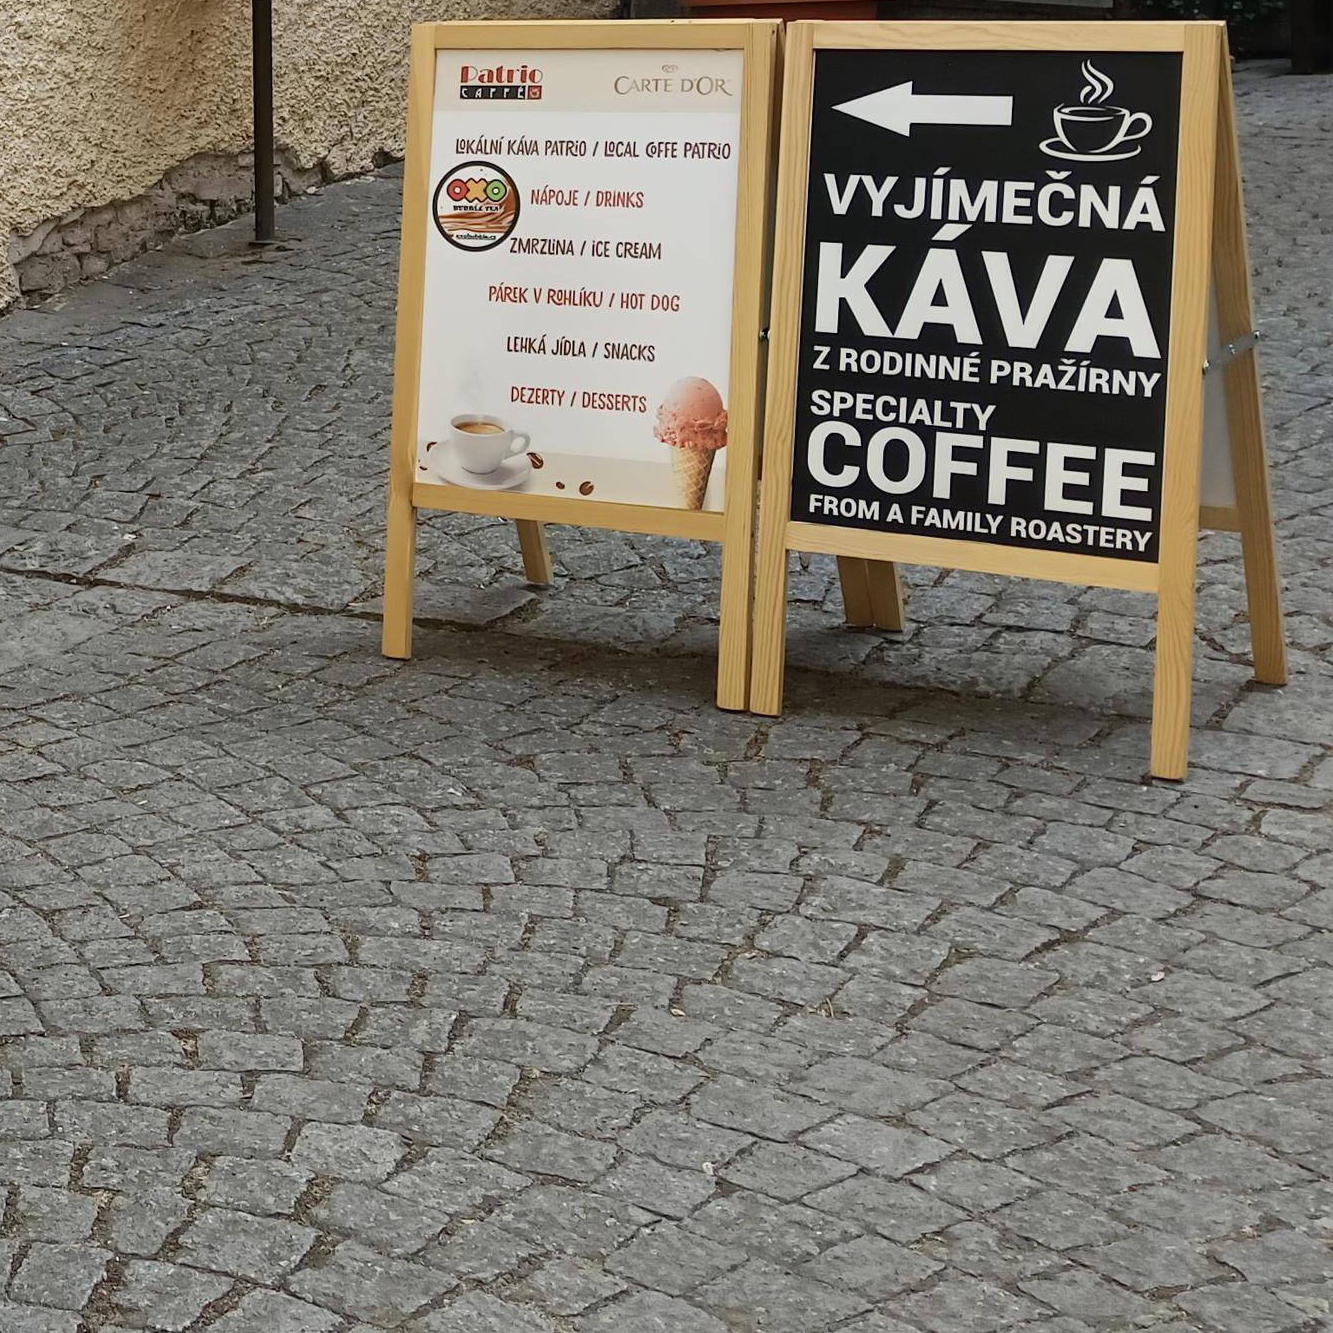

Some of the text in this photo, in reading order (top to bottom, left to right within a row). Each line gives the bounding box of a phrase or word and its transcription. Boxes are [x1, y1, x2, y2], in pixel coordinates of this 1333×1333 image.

[461, 65, 543, 83] Patrio
[614, 75, 733, 96] CARTE D'OR
[455, 134, 505, 155] LOKÁLNÍ
[507, 134, 540, 156] KÁVA
[604, 140, 640, 158] LOCAL
[530, 184, 579, 206] NÁPOJE
[595, 190, 644, 209] DRINKS
[823, 166, 1166, 233] VYJÍMEČNÁ
[615, 241, 662, 260] CREAM
[488, 282, 529, 303] PÁREK
[533, 288, 542, 304] V
[546, 286, 604, 308] ROHLÍKU
[620, 292, 646, 310] HOT
[650, 294, 681, 312] DOG
[813, 223, 1162, 360] KÁVA
[506, 334, 547, 355] LEHKÁ
[551, 336, 587, 358] JÍDLA
[603, 342, 656, 363] SNACKS
[812, 345, 1162, 398] Z RODINNÉ PRAŽÍRNY
[510, 385, 566, 407] DEZERTY
[582, 391, 647, 414] DESSERTS
[810, 389, 997, 431] SPECIALTY
[806, 420, 1157, 523] COFFEE
[809, 494, 1153, 553] FROM A FAMILY ROASTERY
